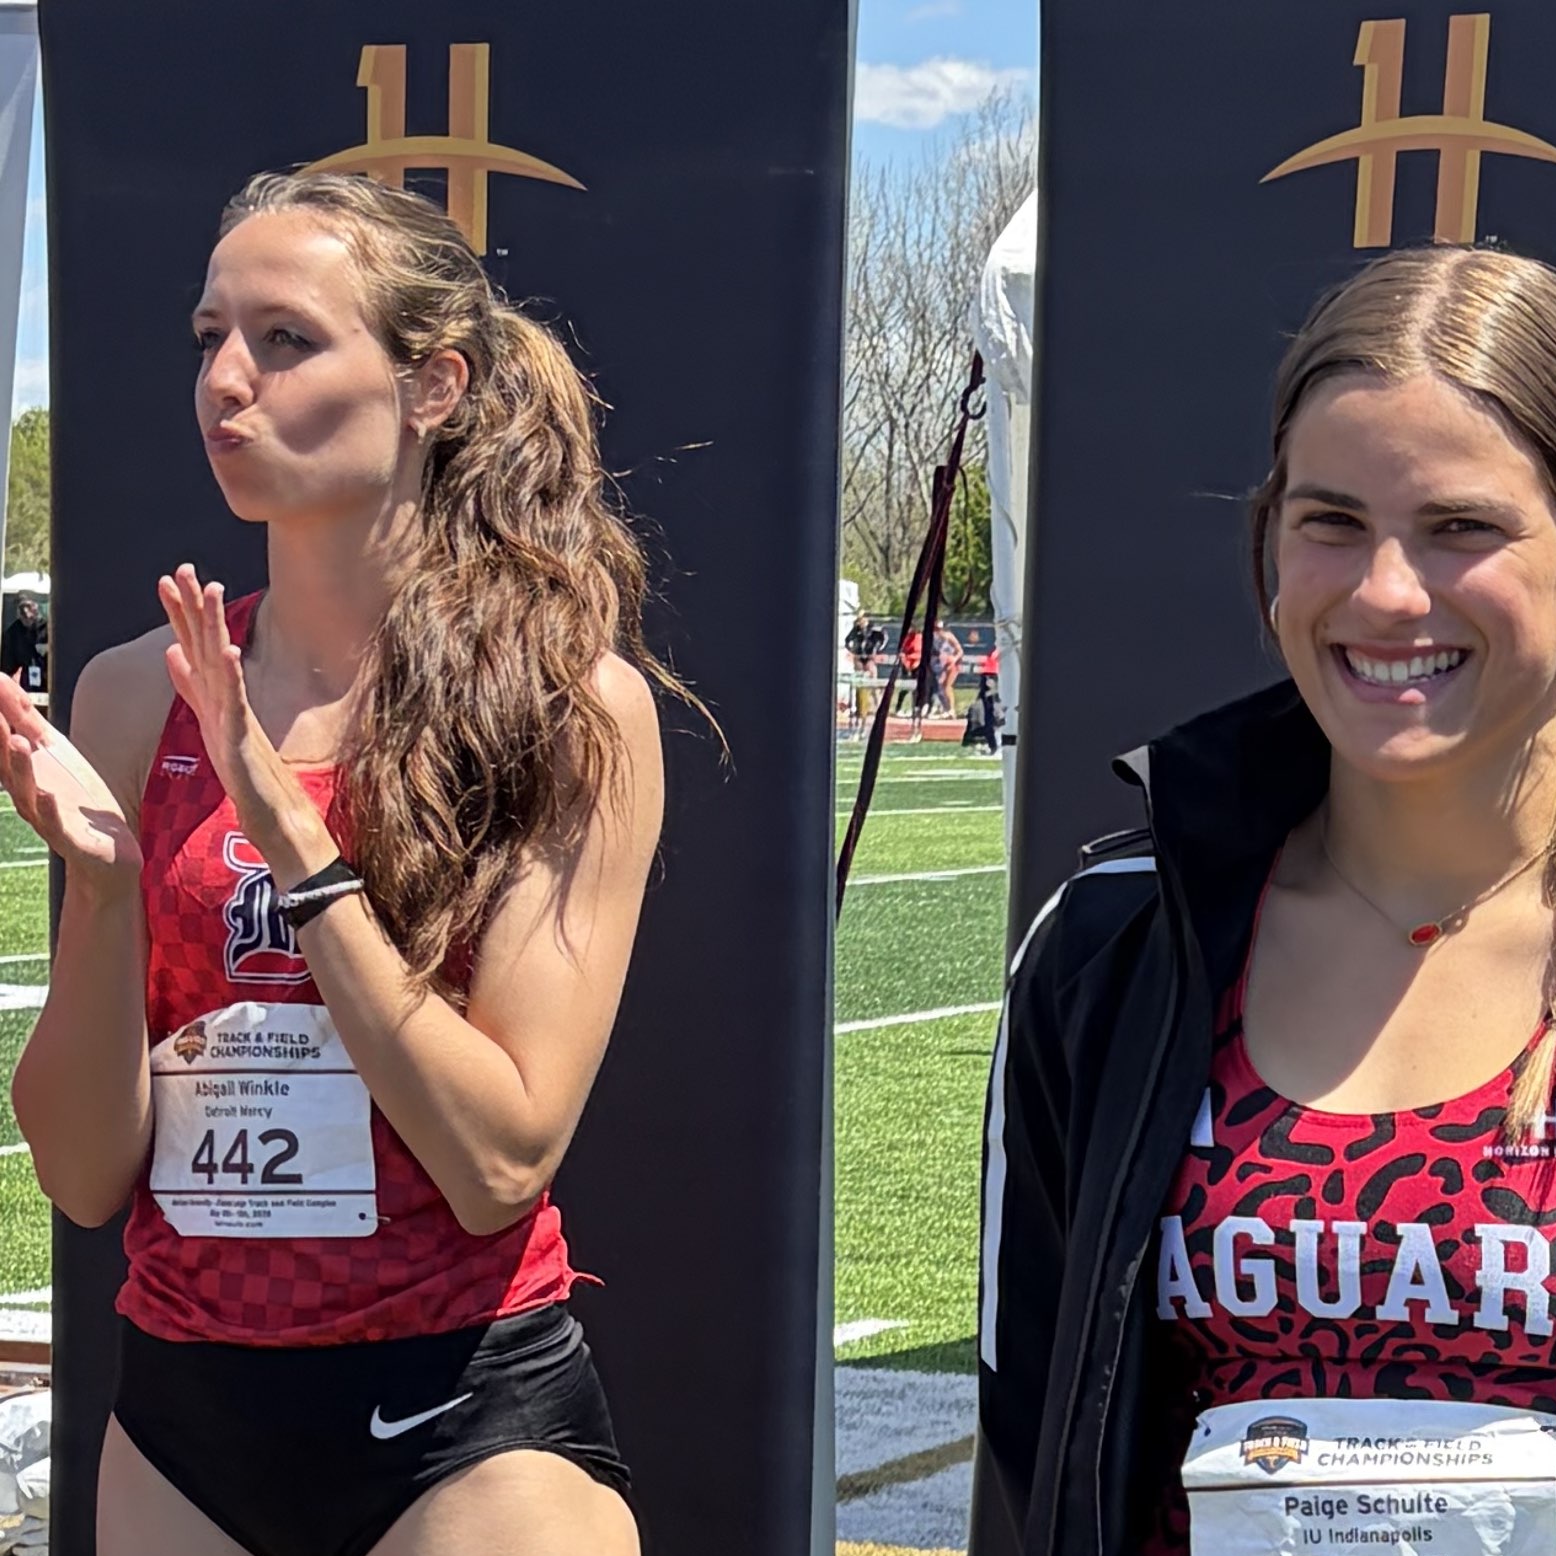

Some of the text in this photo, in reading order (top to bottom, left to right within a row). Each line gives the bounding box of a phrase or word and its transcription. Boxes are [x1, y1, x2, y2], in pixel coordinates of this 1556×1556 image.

[217, 1032, 310, 1044] TRACK & FIELD
[210, 1045, 321, 1059] CHAMPIONSHIPS
[238, 1079, 290, 1096] Winkle
[191, 1128, 303, 1185] 442
[1482, 1144, 1550, 1159] HORIZON
[1334, 1437, 1399, 1451] TRACK
[1423, 1437, 1483, 1451] FIELD
[1317, 1451, 1494, 1467] CHAMPIONSHIPS
[1284, 1492, 1448, 1520] Paige Schulte
[1303, 1526, 1433, 1546] IU Indianapolis
